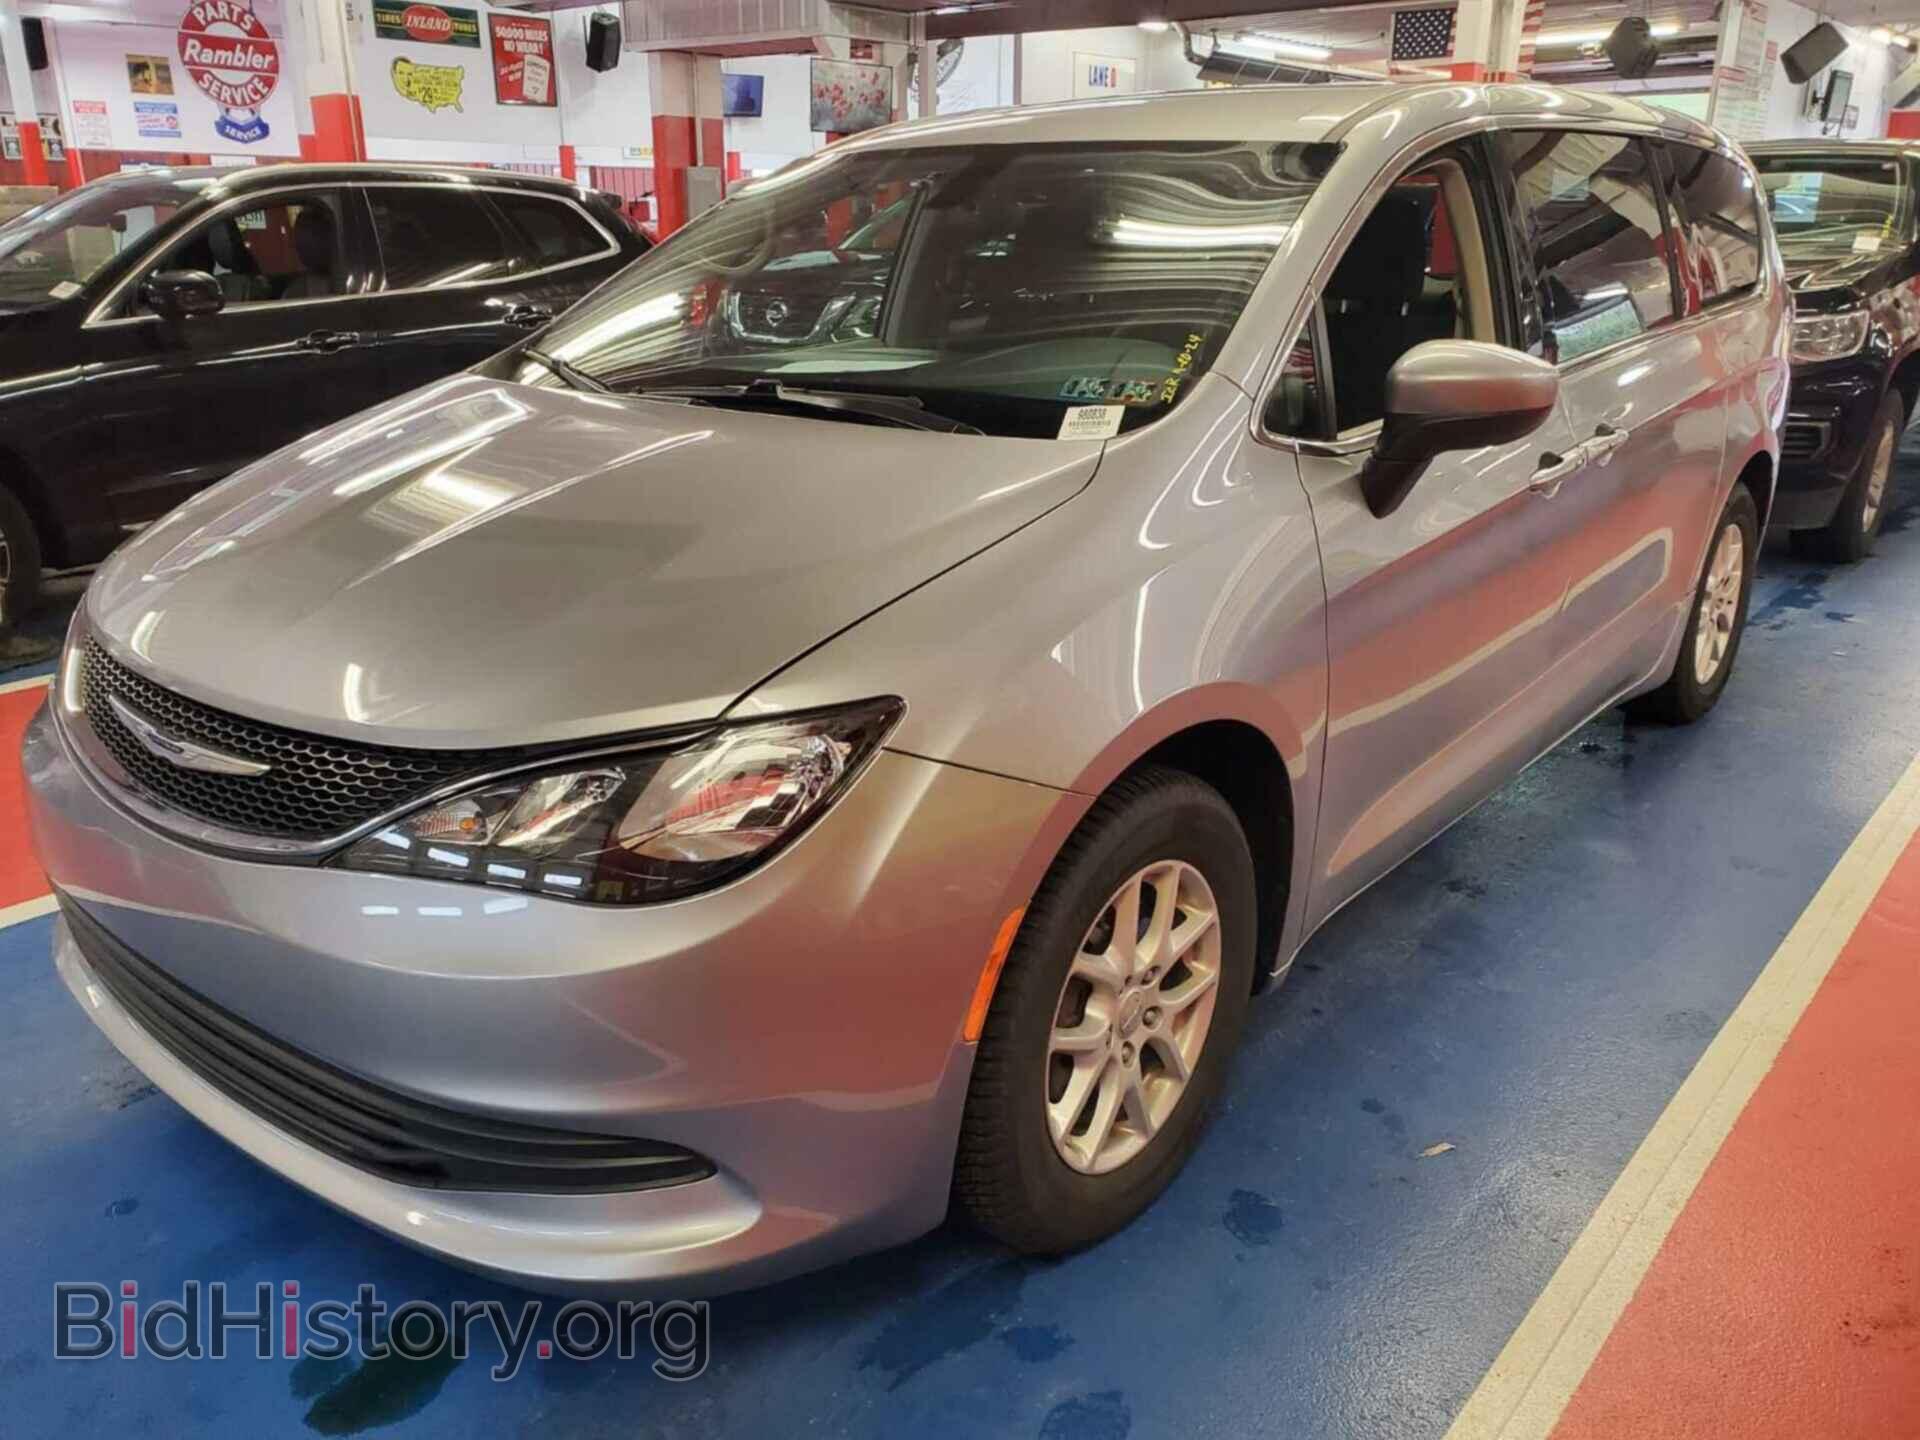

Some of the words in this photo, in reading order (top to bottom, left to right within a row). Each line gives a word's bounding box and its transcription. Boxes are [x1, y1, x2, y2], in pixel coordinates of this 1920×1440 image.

[192, 0, 255, 31] PARTS
[406, 15, 450, 32] INLAND
[184, 38, 274, 69] Rambler
[199, 72, 269, 105] SERVICE
[1088, 64, 1108, 88] LANE
